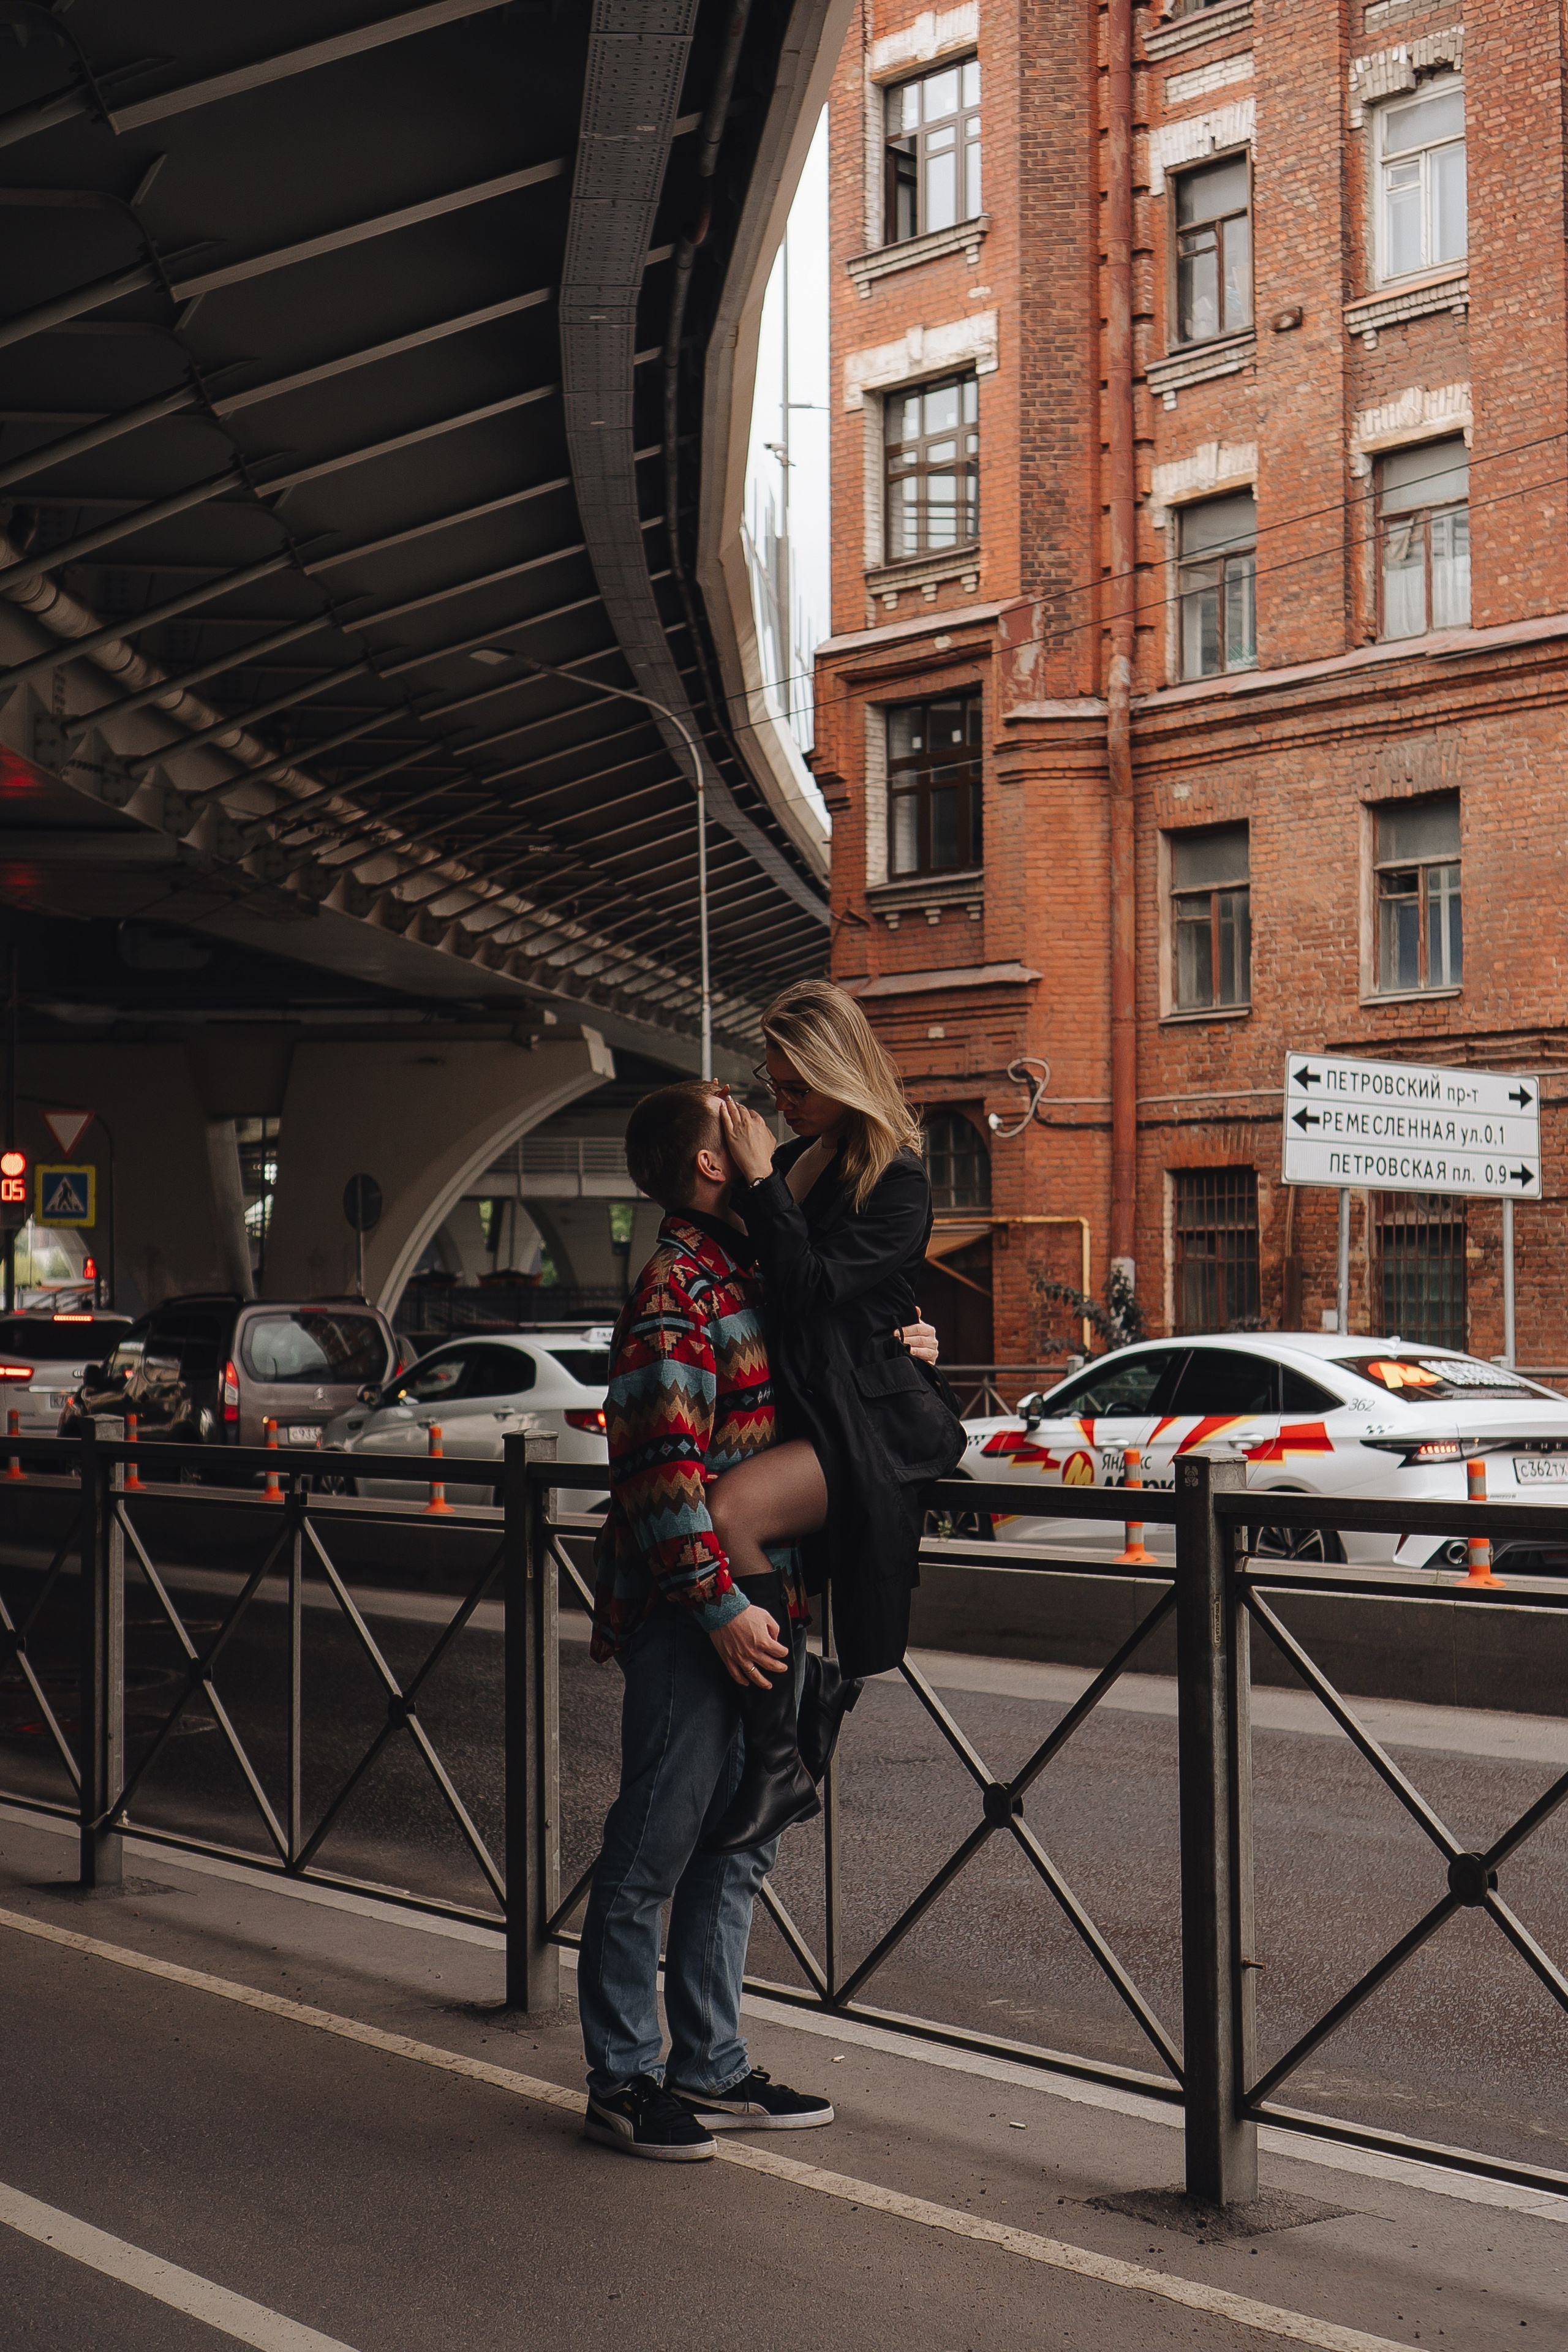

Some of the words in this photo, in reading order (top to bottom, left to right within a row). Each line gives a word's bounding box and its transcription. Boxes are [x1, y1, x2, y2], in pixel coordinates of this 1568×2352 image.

[1327, 1070, 1441, 1099] ПЕТРОВСКИЙ
[1447, 1087, 1479, 1107] пр-т
[1323, 1110, 1455, 1140] РЕМЕСЛЕННАЯ
[1330, 1153, 1447, 1180] ПЕТРОВСКАЯ
[1453, 1167, 1476, 1182] пл.
[1485, 1164, 1507, 1185] 0,9
[1, 1178, 25, 1201] 05
[1348, 1398, 1376, 1412] 362
